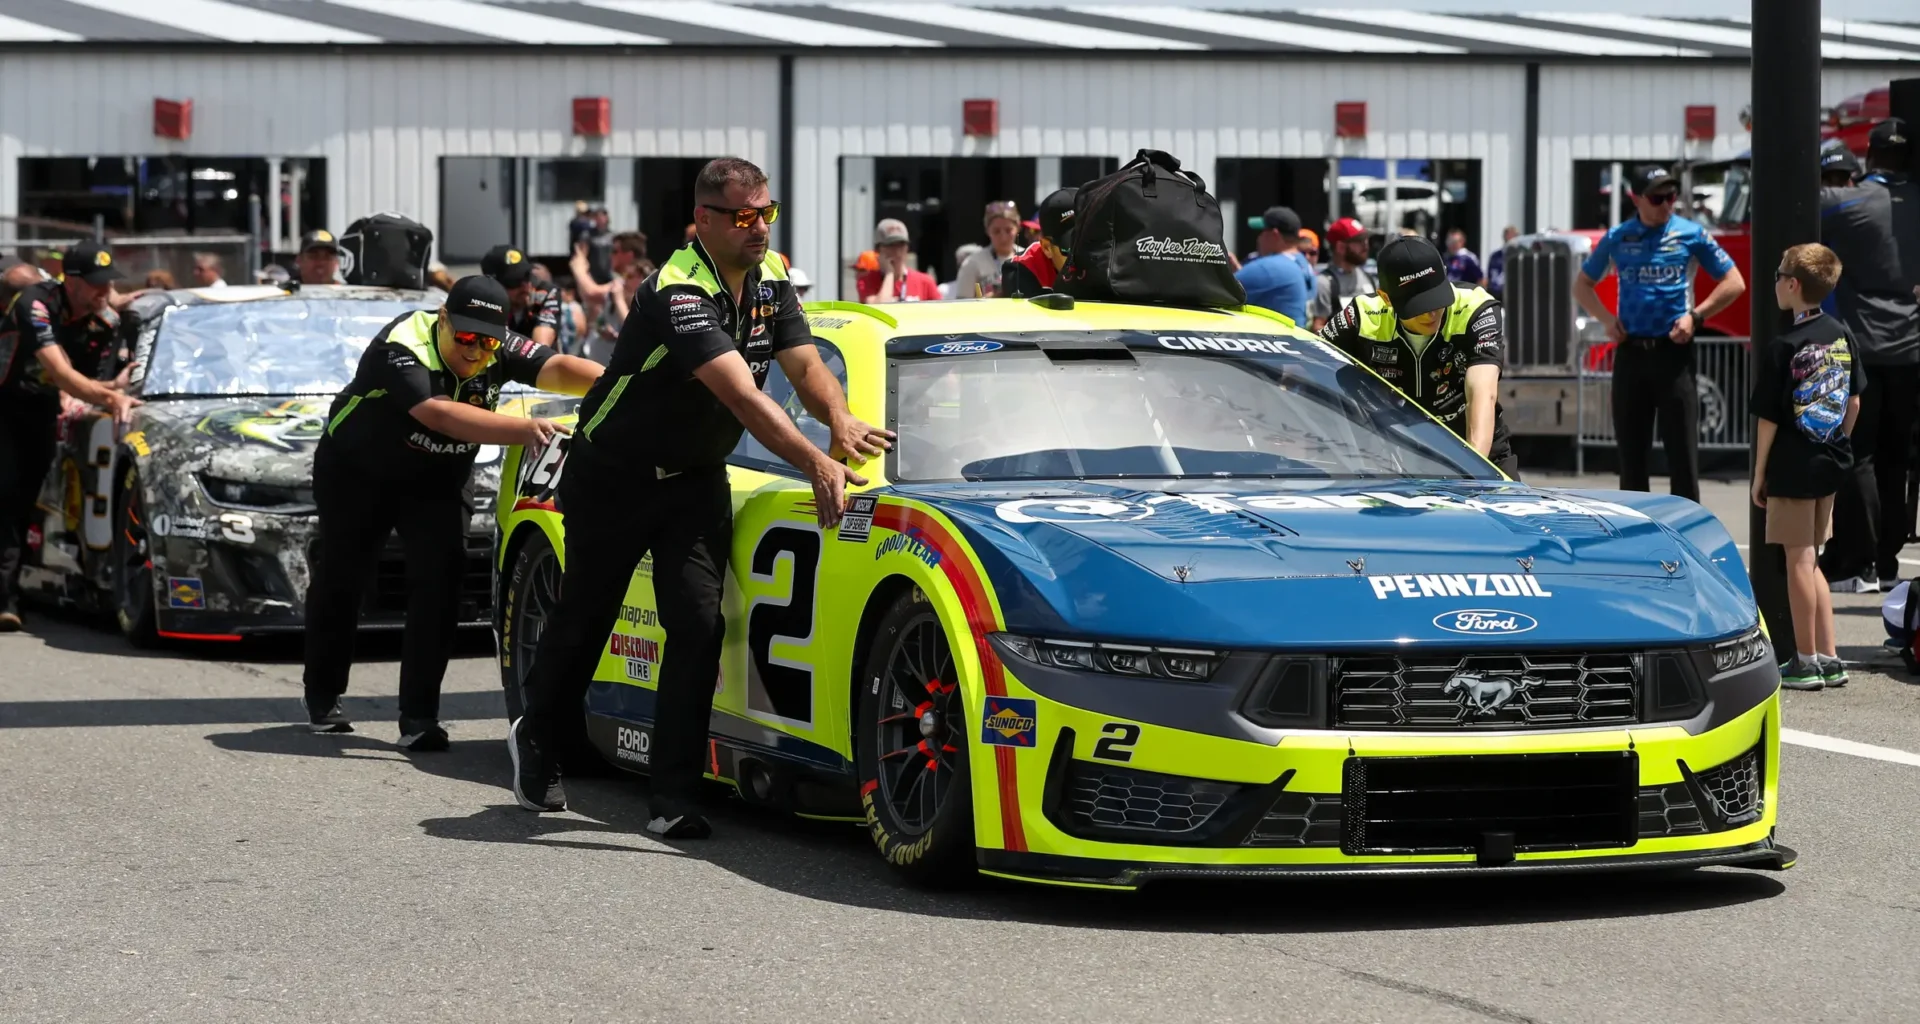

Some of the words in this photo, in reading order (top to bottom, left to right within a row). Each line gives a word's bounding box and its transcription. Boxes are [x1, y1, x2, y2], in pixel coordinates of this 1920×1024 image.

[1136, 236, 1163, 256] Troy
[1163, 237, 1182, 255] Lee
[1182, 237, 1226, 258] Designs
[1399, 267, 1433, 282] MENARDS
[1638, 265, 1684, 279] ALLOY
[670, 294, 702, 302] FORD
[670, 302, 701, 311] ODYSSEY
[674, 320, 712, 333] Mazak
[678, 313, 708, 321] DETROIT
[1157, 335, 1301, 354] CINDRIC
[409, 431, 477, 454] MENARD
[85, 414, 113, 549] 3
[854, 499, 873, 512] NASCAR
[219, 512, 256, 545] 3
[844, 517, 854, 531] CUP
[853, 517, 868, 531] SERIES
[875, 532, 942, 570] GOODYEAR
[1367, 572, 1553, 600] PENNZOIL
[619, 604, 657, 628] nap-on
[748, 520, 823, 730] 2
[1455, 611, 1520, 633] Ford
[503, 588, 515, 668] EAGLE
[610, 632, 660, 664] DISCOUNT
[627, 661, 649, 678] TIRE
[986, 716, 1034, 731] SUNOCO
[617, 726, 650, 753] FORD
[1092, 722, 1141, 763] 2
[616, 747, 650, 765] PERFORMANCE
